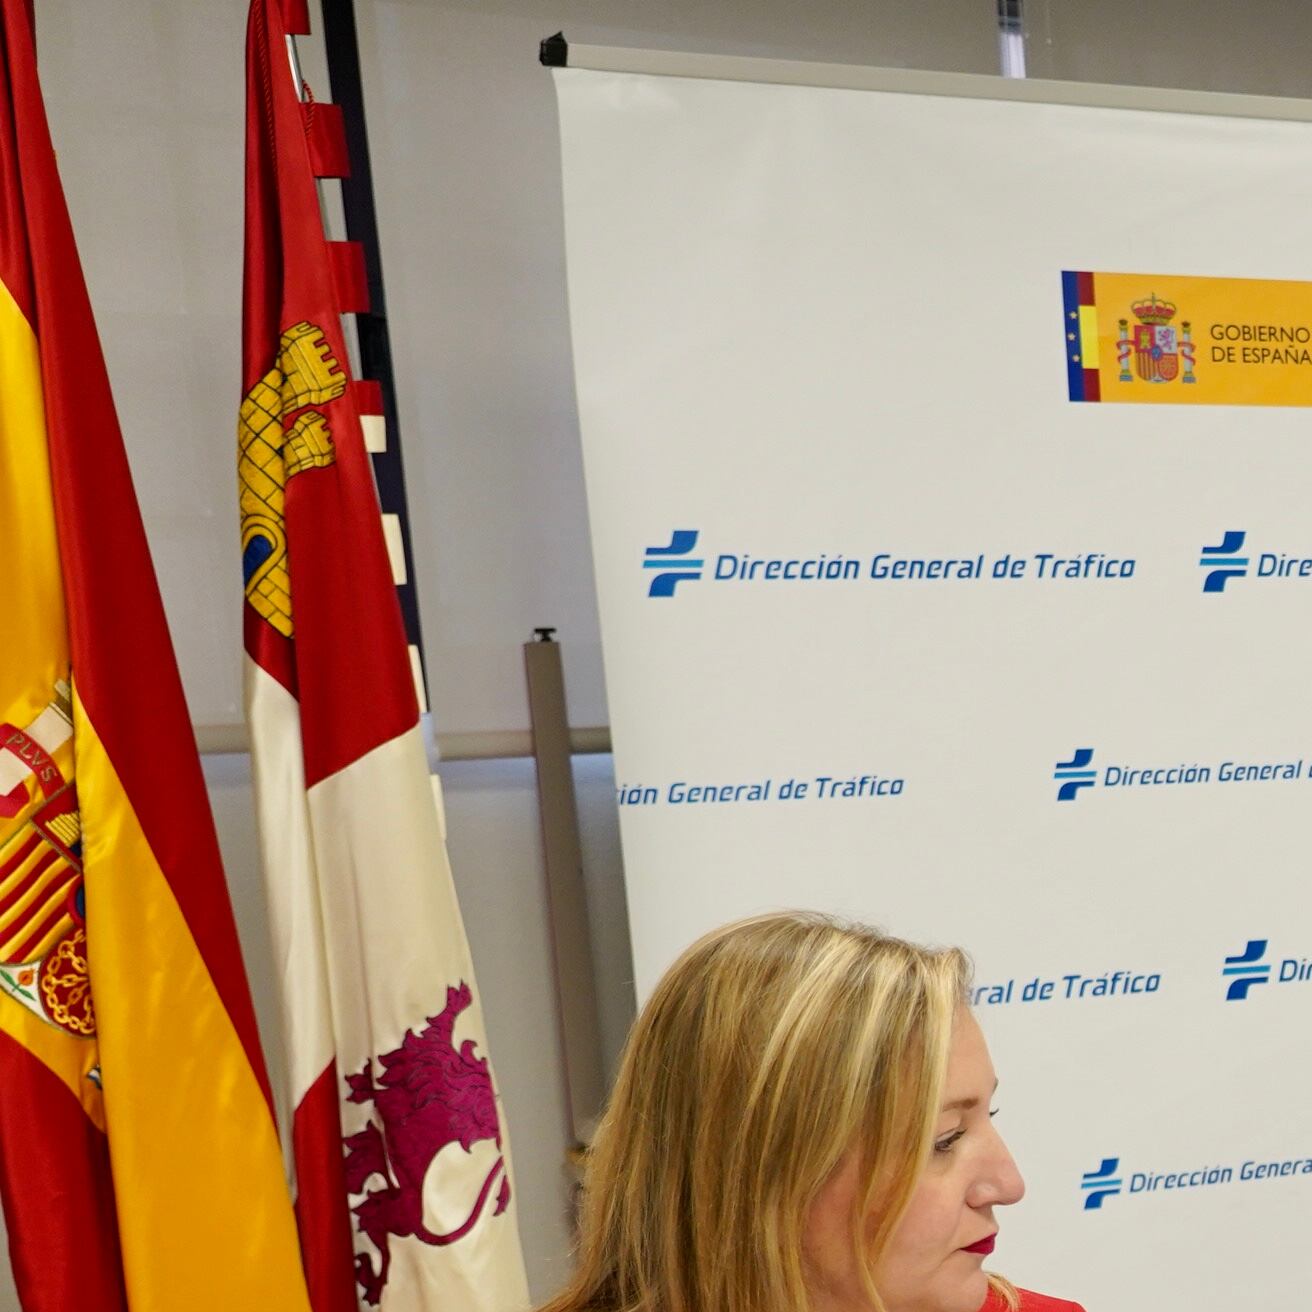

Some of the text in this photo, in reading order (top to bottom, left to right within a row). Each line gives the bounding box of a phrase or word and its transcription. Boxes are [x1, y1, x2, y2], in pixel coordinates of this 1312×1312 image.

[1209, 324, 1311, 344] GOBIERNO
[1212, 345, 1312, 364] DE ESPAÑA
[715, 554, 1135, 580] Dirección General de Tráfico
[1105, 765, 1210, 786] Dirección
[1218, 760, 1302, 781] General
[668, 780, 770, 803] General
[779, 780, 808, 799] de
[816, 776, 904, 798] Tráfico
[1022, 978, 1054, 1001] de
[1063, 971, 1160, 998] Tráfico
[1130, 1167, 1232, 1193] Dirección
